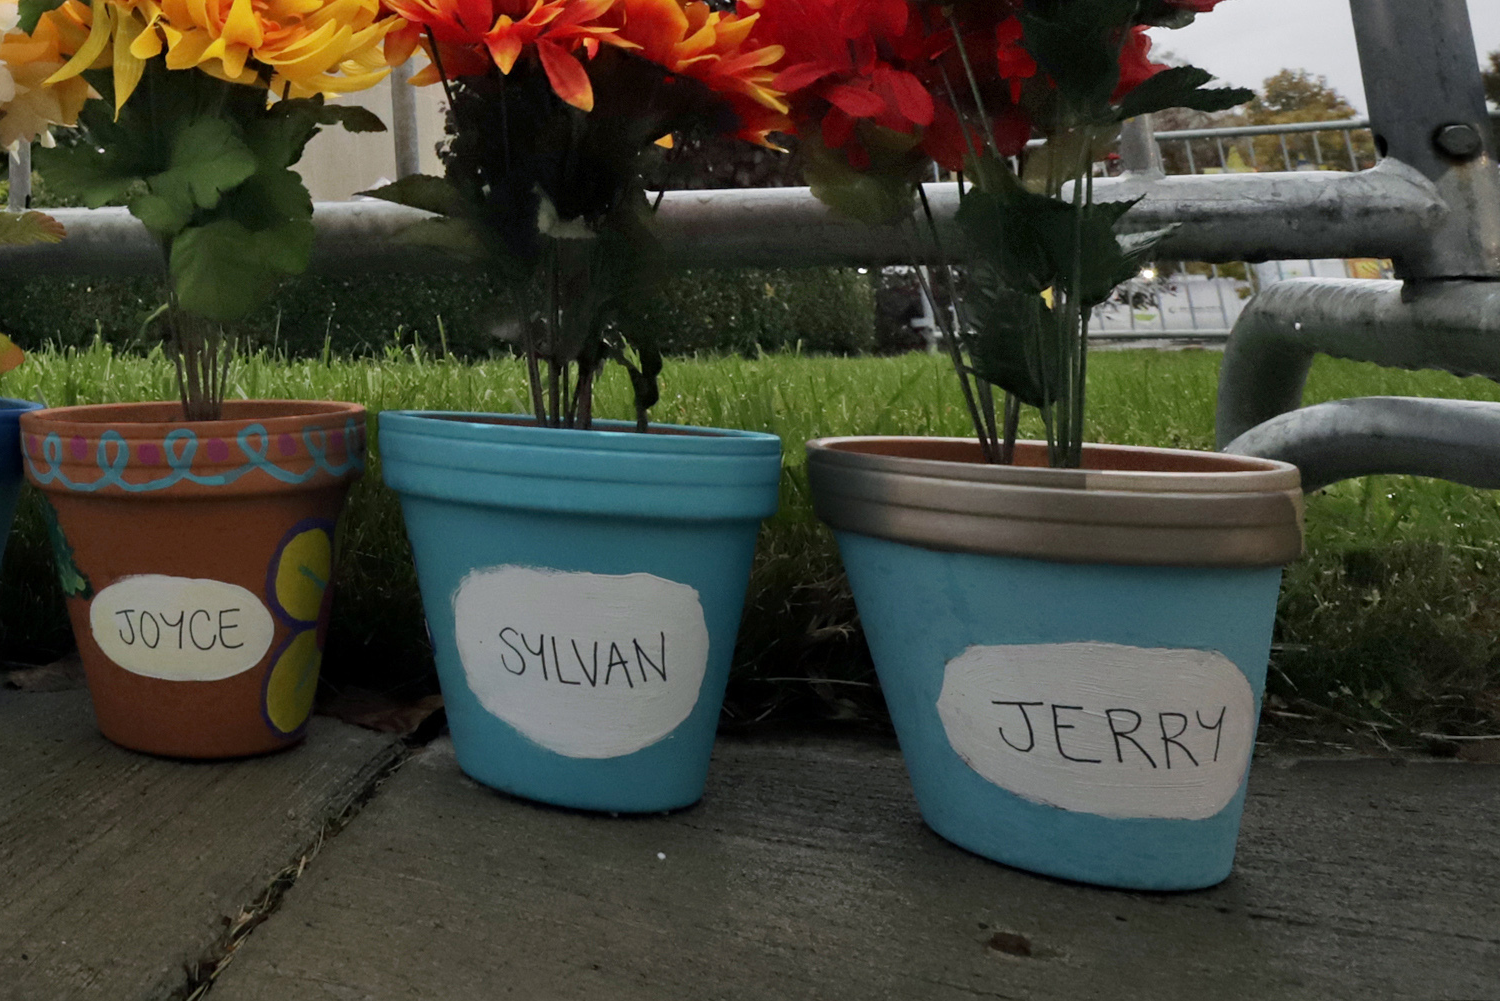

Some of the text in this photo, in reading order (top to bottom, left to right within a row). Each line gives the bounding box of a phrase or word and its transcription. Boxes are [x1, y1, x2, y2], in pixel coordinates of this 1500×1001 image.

[114, 607, 245, 653] JOYCE
[498, 626, 670, 689] SYLVAN
[990, 700, 1228, 771] JERRY
